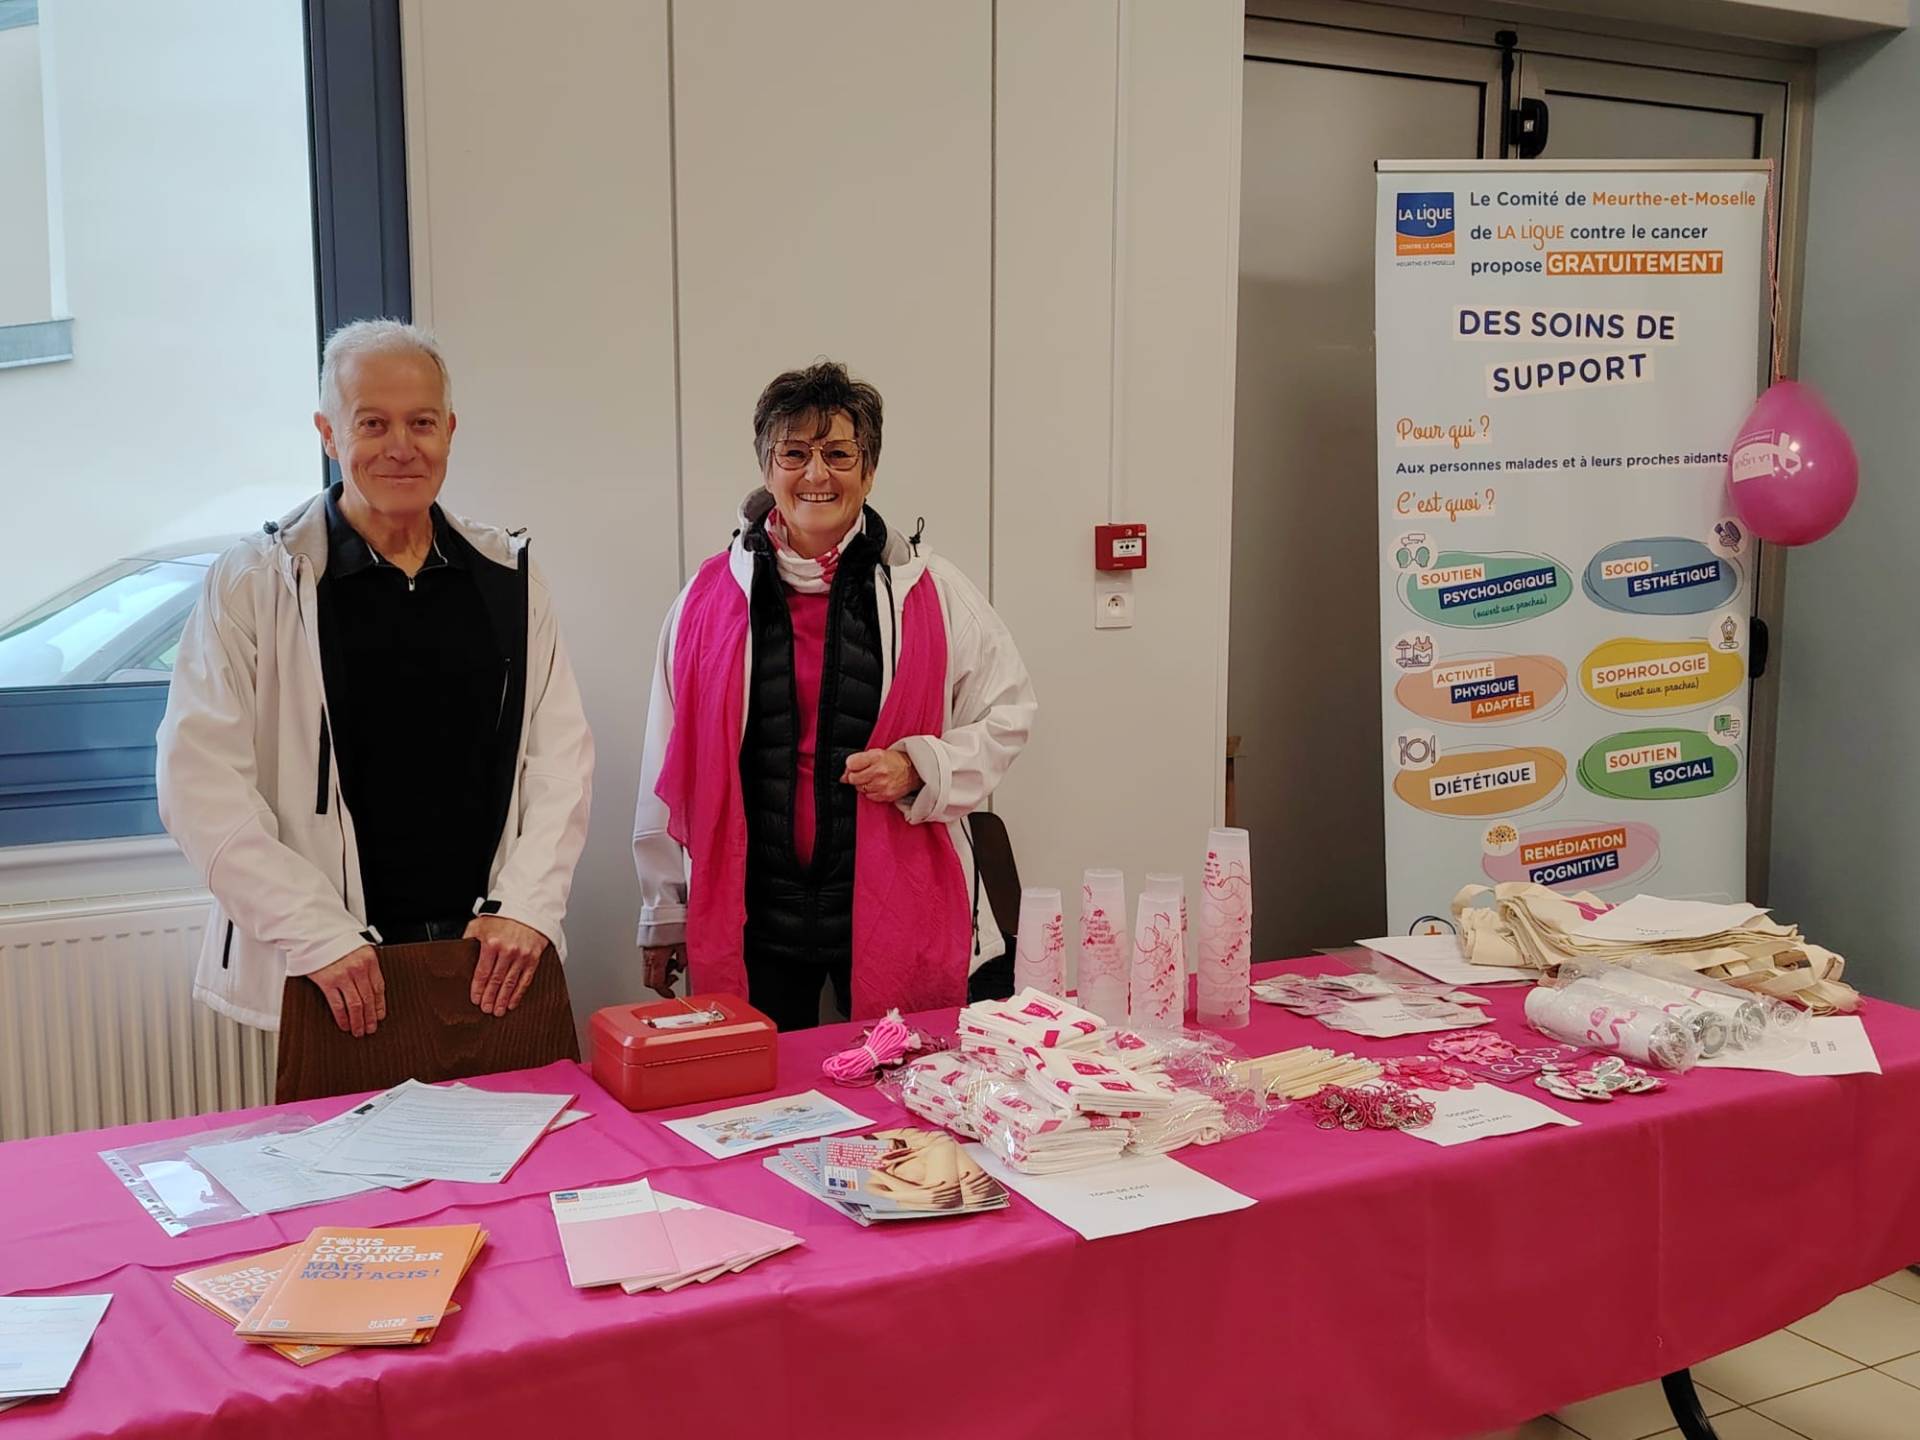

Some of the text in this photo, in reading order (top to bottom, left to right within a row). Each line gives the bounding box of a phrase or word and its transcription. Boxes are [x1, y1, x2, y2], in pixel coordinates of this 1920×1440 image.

[1470, 190, 1756, 206] Le Comité de Meurthe-et-Moselle
[1398, 208, 1414, 221] LA
[1470, 225, 1493, 240] de
[1497, 225, 1516, 240] LA
[1570, 225, 1626, 240] contre
[1631, 224, 1646, 240] le
[1651, 226, 1708, 240] cancer
[1471, 253, 1723, 276] propose GRATUITEMENT
[1459, 310, 1675, 340] DES SOINS DE
[1492, 353, 1647, 393] SUPPORT
[1396, 415, 1490, 449] Pour qui ?
[1396, 452, 1729, 475] Aux personnes malades et à leurs proches aidants
[1396, 488, 1495, 523] C'est quoi ?
[1420, 567, 1483, 586] SOUTIEN
[1604, 560, 1649, 577] SOCIO
[1633, 565, 1717, 593] ESTHÉTIQUE
[1443, 572, 1555, 605] PSYCHOLOGIQUE
[1436, 664, 1494, 684] ACTIVITÉ
[1596, 657, 1707, 685] SOPHROLOGIE
[1454, 679, 1517, 700] PHYSIQUE
[1476, 693, 1531, 715] ADAPTÉE
[1609, 746, 1678, 769] SOUTIEN
[1434, 767, 1531, 797] DIÉTÉTIQUE
[1653, 762, 1712, 785] SOCIAL
[1524, 832, 1624, 861] REMÉDIATION
[1533, 853, 1616, 884] COGNITIVE
[310, 1251, 445, 1264] LE CANCER
[315, 1245, 417, 1255] CONTRE
[305, 1262, 364, 1271] MAIS
